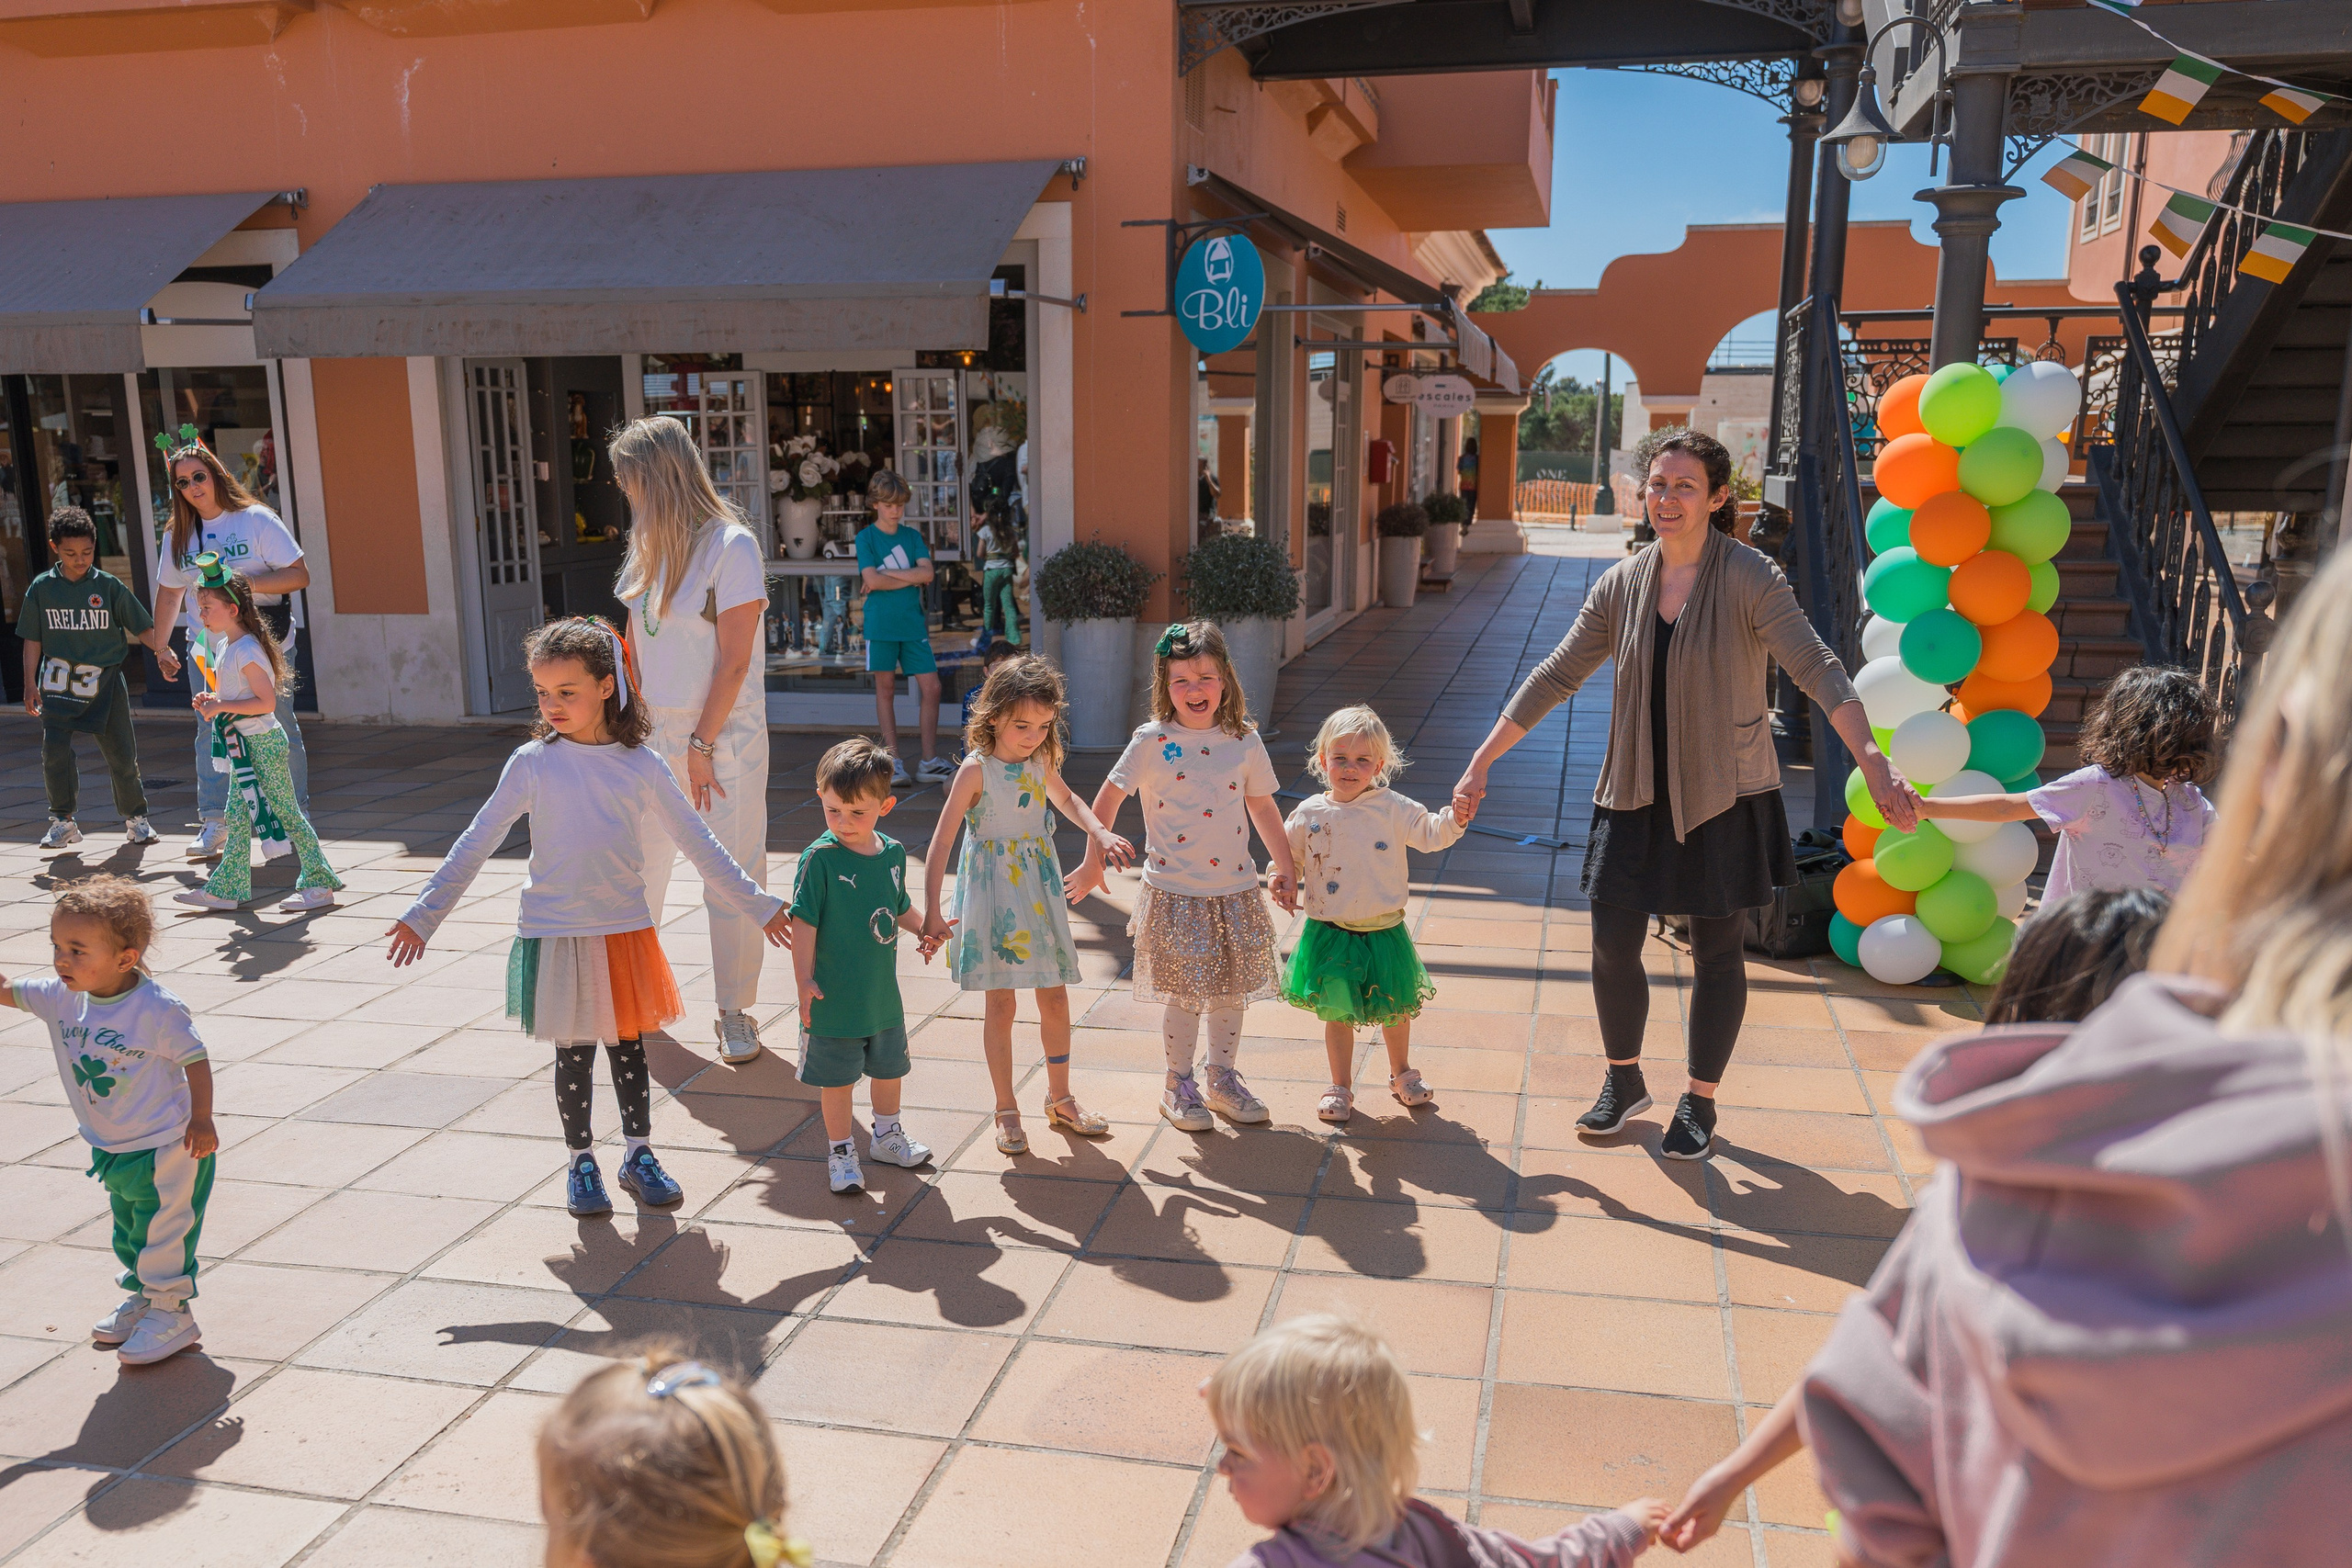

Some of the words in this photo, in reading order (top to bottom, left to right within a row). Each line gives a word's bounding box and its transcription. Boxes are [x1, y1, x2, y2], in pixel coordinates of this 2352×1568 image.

[1182, 287, 1250, 330] Bli
[1536, 468, 1567, 479] ONE
[45, 608, 109, 630] IRELAND
[42, 658, 104, 698] 03
